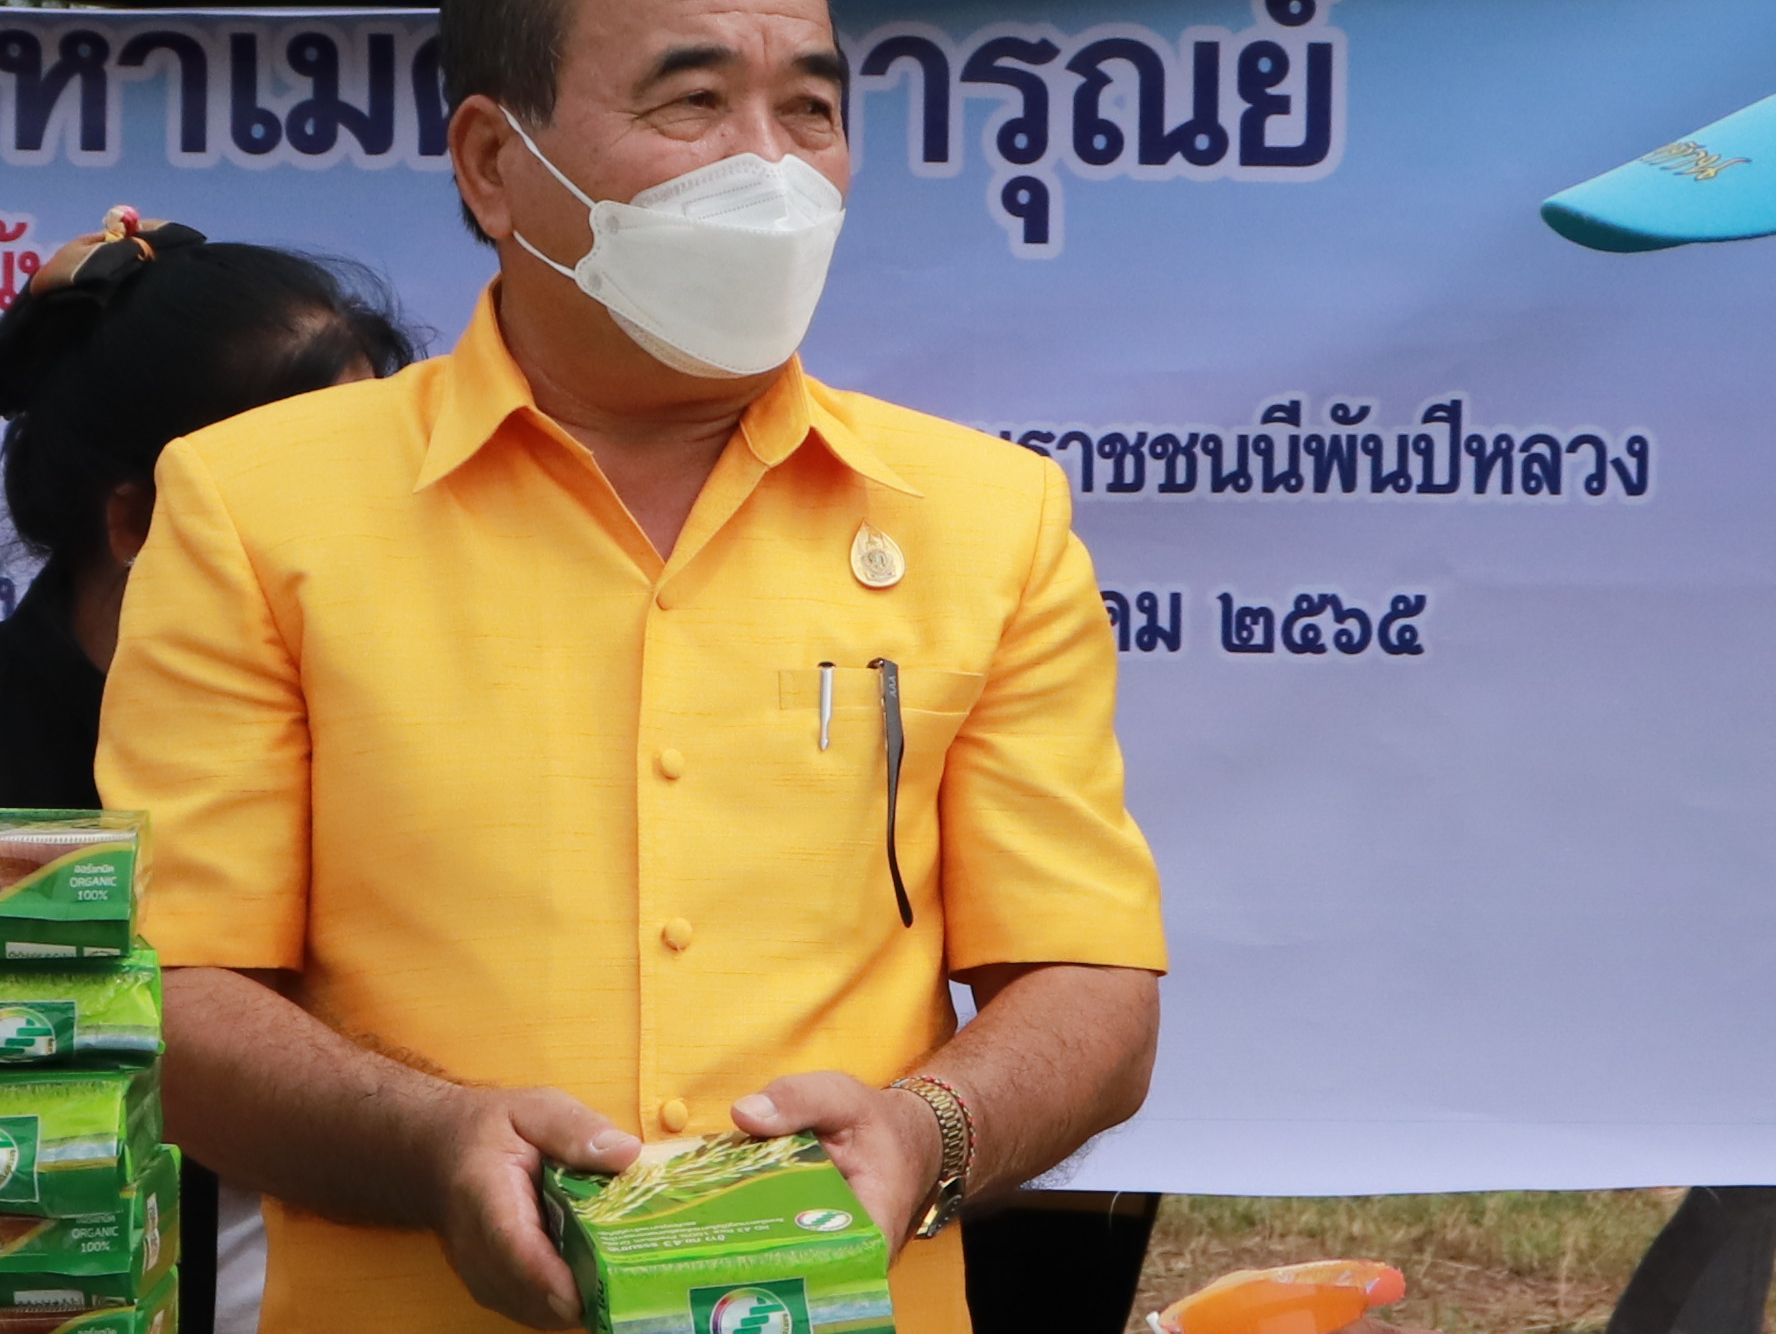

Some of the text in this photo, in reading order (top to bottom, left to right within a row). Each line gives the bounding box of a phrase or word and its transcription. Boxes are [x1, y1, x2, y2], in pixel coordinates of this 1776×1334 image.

[1216, 591, 1427, 655] ๒๕๖๕
[69, 876, 118, 888] ORGANIC
[77, 890, 109, 901] 100%
[73, 1226, 119, 1240] ORGANIC
[80, 1241, 111, 1253] 100%
